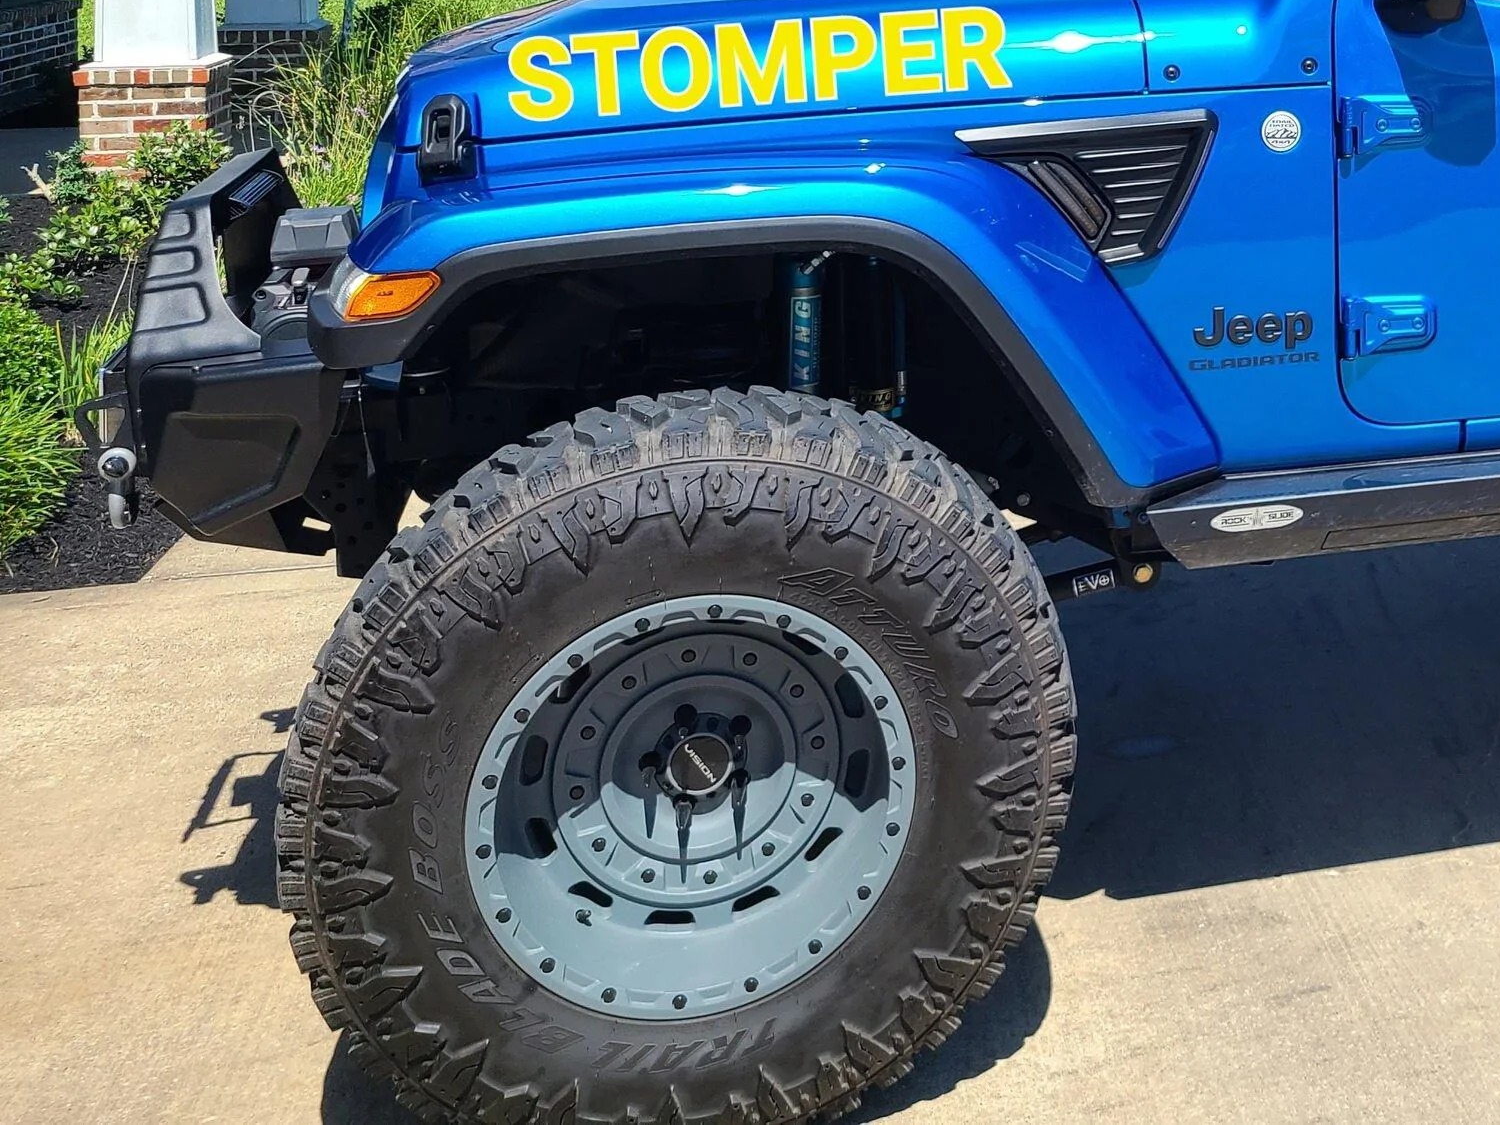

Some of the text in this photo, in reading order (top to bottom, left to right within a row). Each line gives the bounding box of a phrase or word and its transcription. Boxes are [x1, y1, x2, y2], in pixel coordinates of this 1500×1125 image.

[507, 6, 1013, 122] STOMPER
[794, 301, 811, 381] KING
[1193, 306, 1313, 349] Jeep
[1189, 352, 1320, 371] GLADIATOR
[1221, 512, 1294, 525] ROCK SLIDE
[1077, 574, 1110, 592] EVO
[777, 567, 959, 739] ATTURO
[684, 743, 717, 783] VISION
[408, 710, 778, 1074] TRAIL BLADE BOSS
